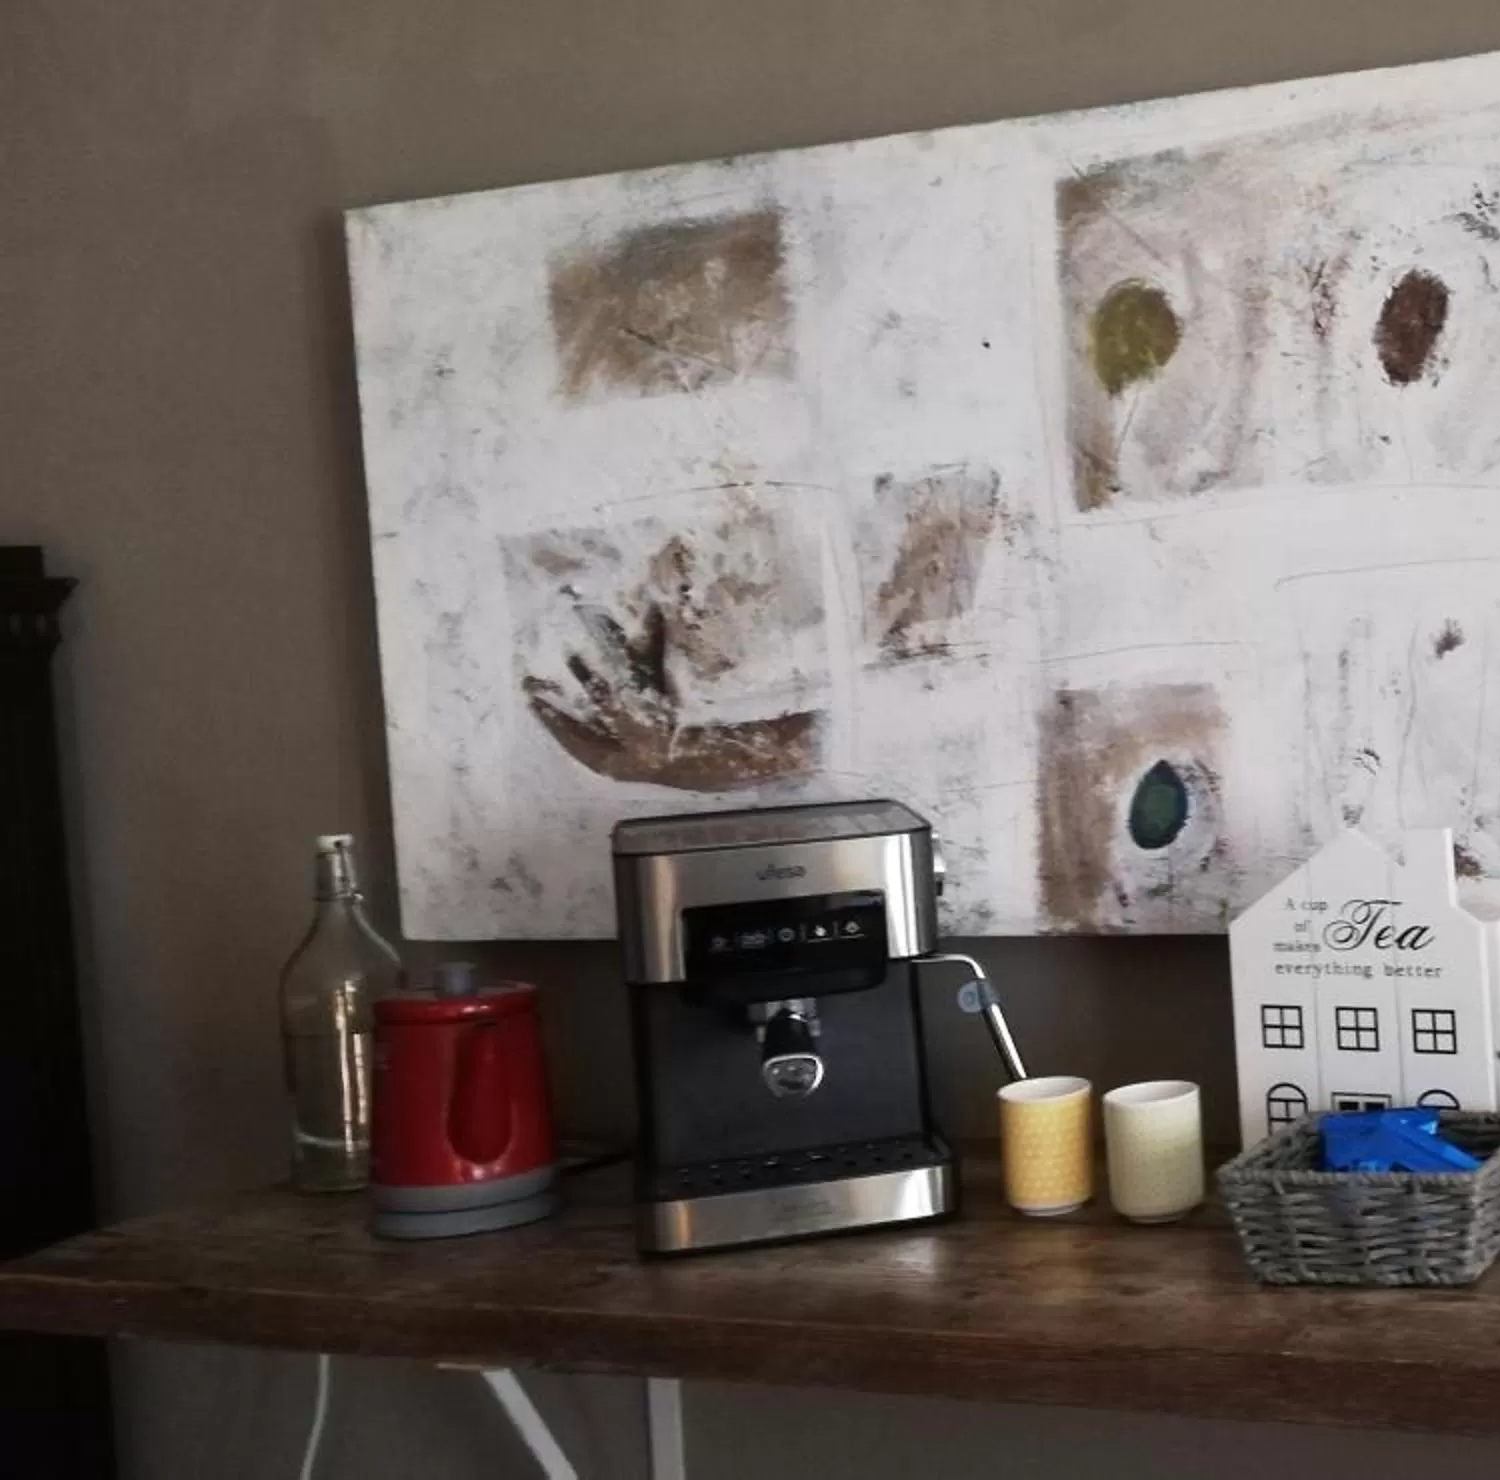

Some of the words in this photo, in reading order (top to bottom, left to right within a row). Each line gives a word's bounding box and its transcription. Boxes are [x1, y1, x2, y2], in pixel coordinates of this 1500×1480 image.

[1283, 897, 1297, 911] A
[1300, 901, 1328, 914] cup
[1293, 919, 1312, 933] of
[1322, 899, 1435, 951] Tea
[1274, 962, 1373, 979] everything
[1383, 962, 1443, 979] better
